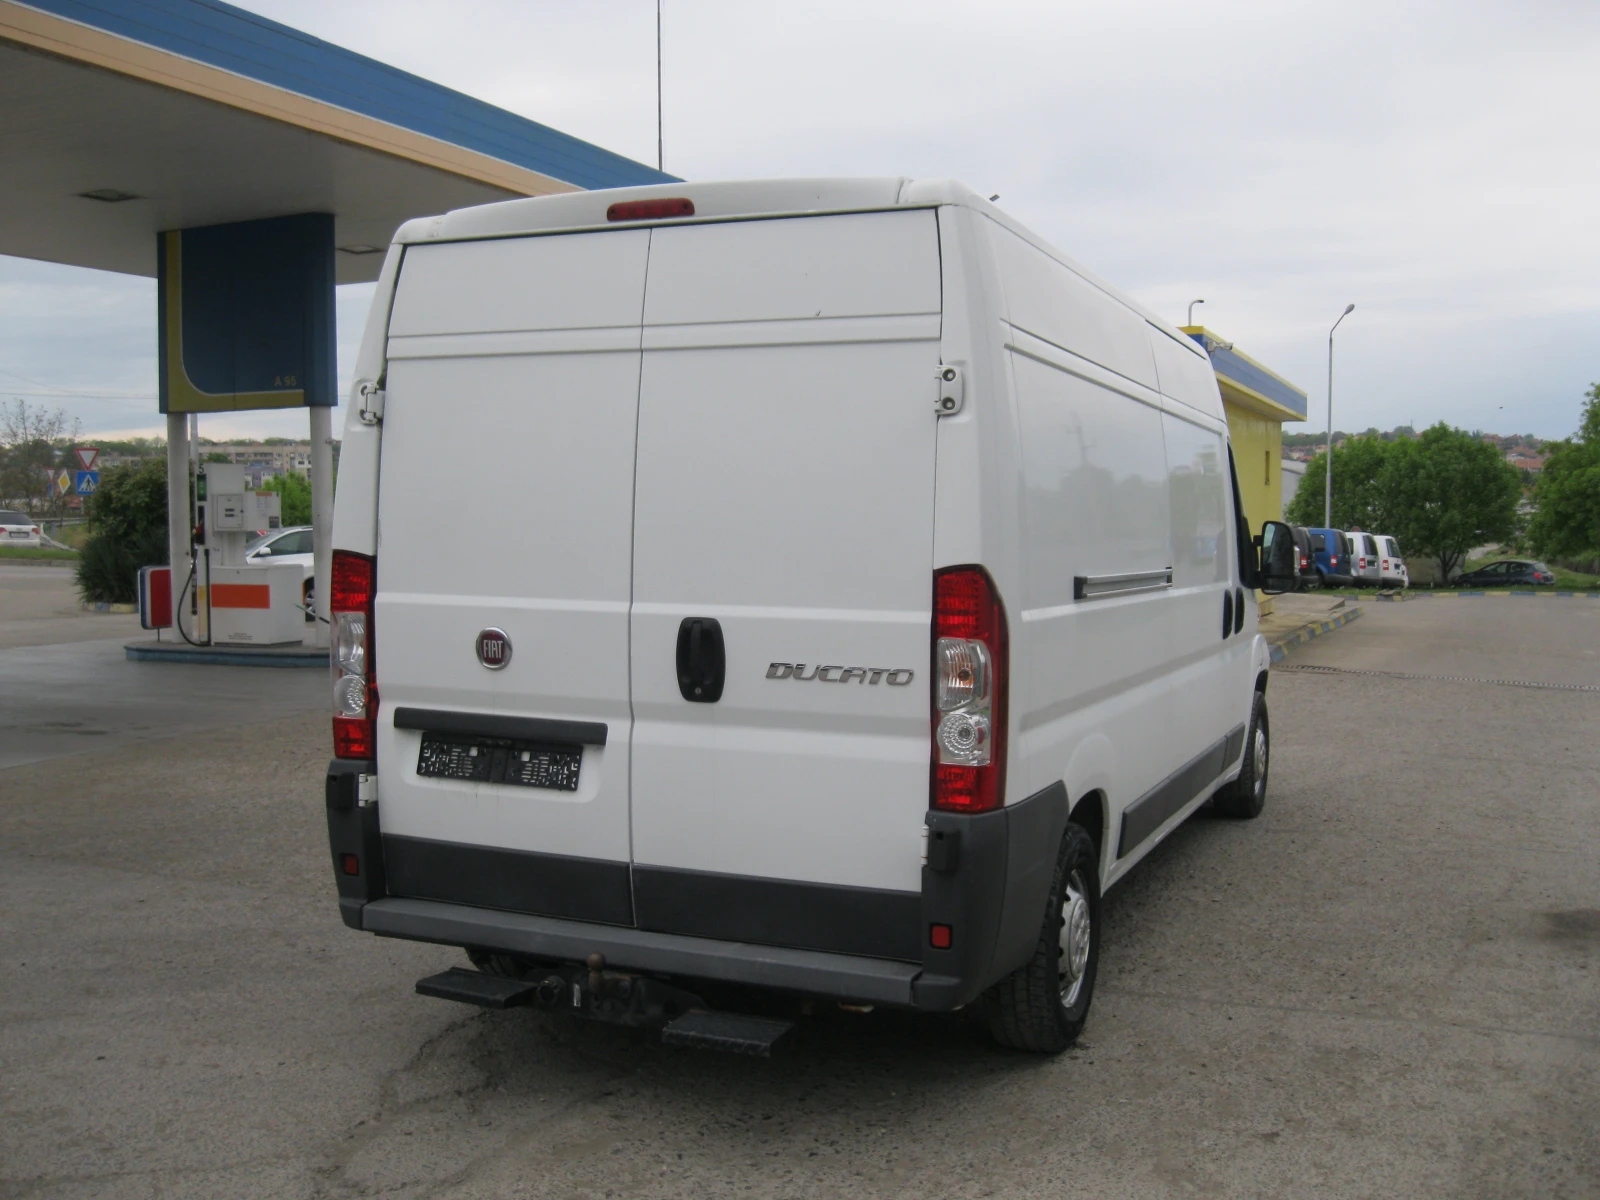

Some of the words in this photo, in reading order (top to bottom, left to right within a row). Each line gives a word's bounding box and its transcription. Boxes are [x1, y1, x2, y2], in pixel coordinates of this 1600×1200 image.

[274, 375, 282, 387] A
[283, 375, 297, 387] 95
[483, 639, 504, 659] FIAT
[765, 662, 914, 686] DUCATO
